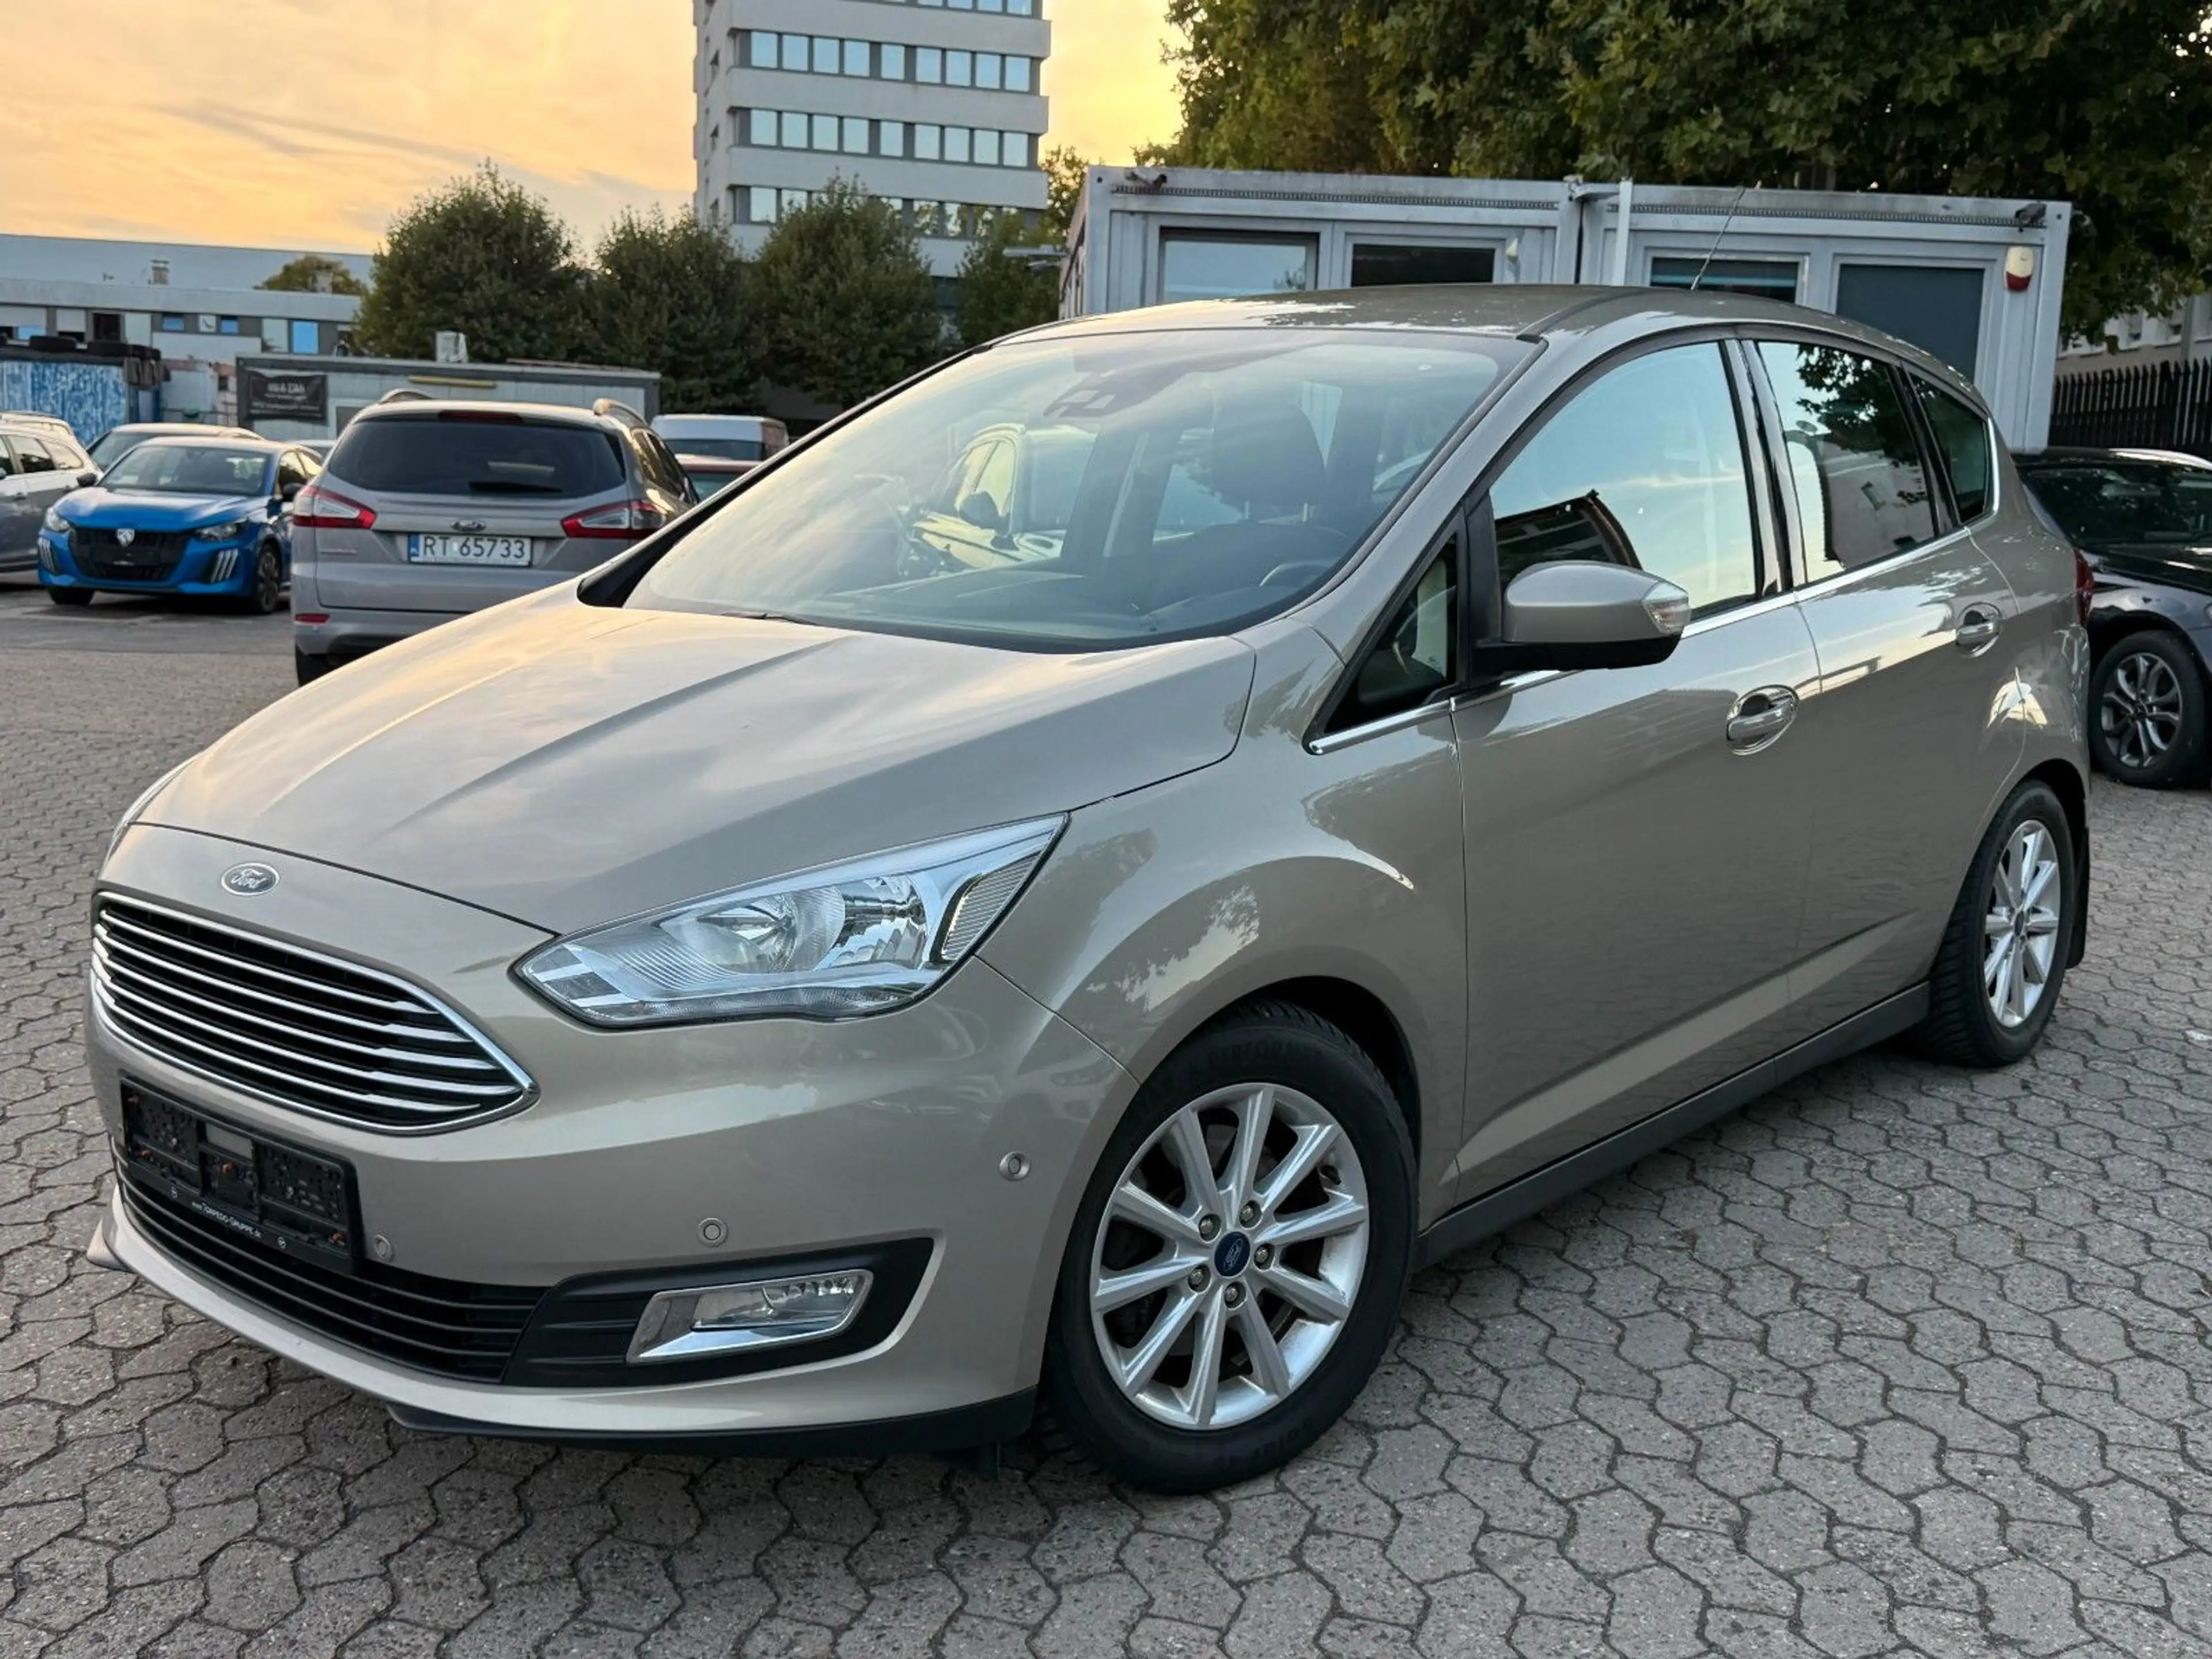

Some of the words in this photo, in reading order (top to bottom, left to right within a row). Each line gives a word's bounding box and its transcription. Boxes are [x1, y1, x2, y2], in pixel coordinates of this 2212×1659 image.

[423, 535, 450, 556] RT
[459, 536, 525, 558] 65733
[231, 868, 267, 889] Ford
